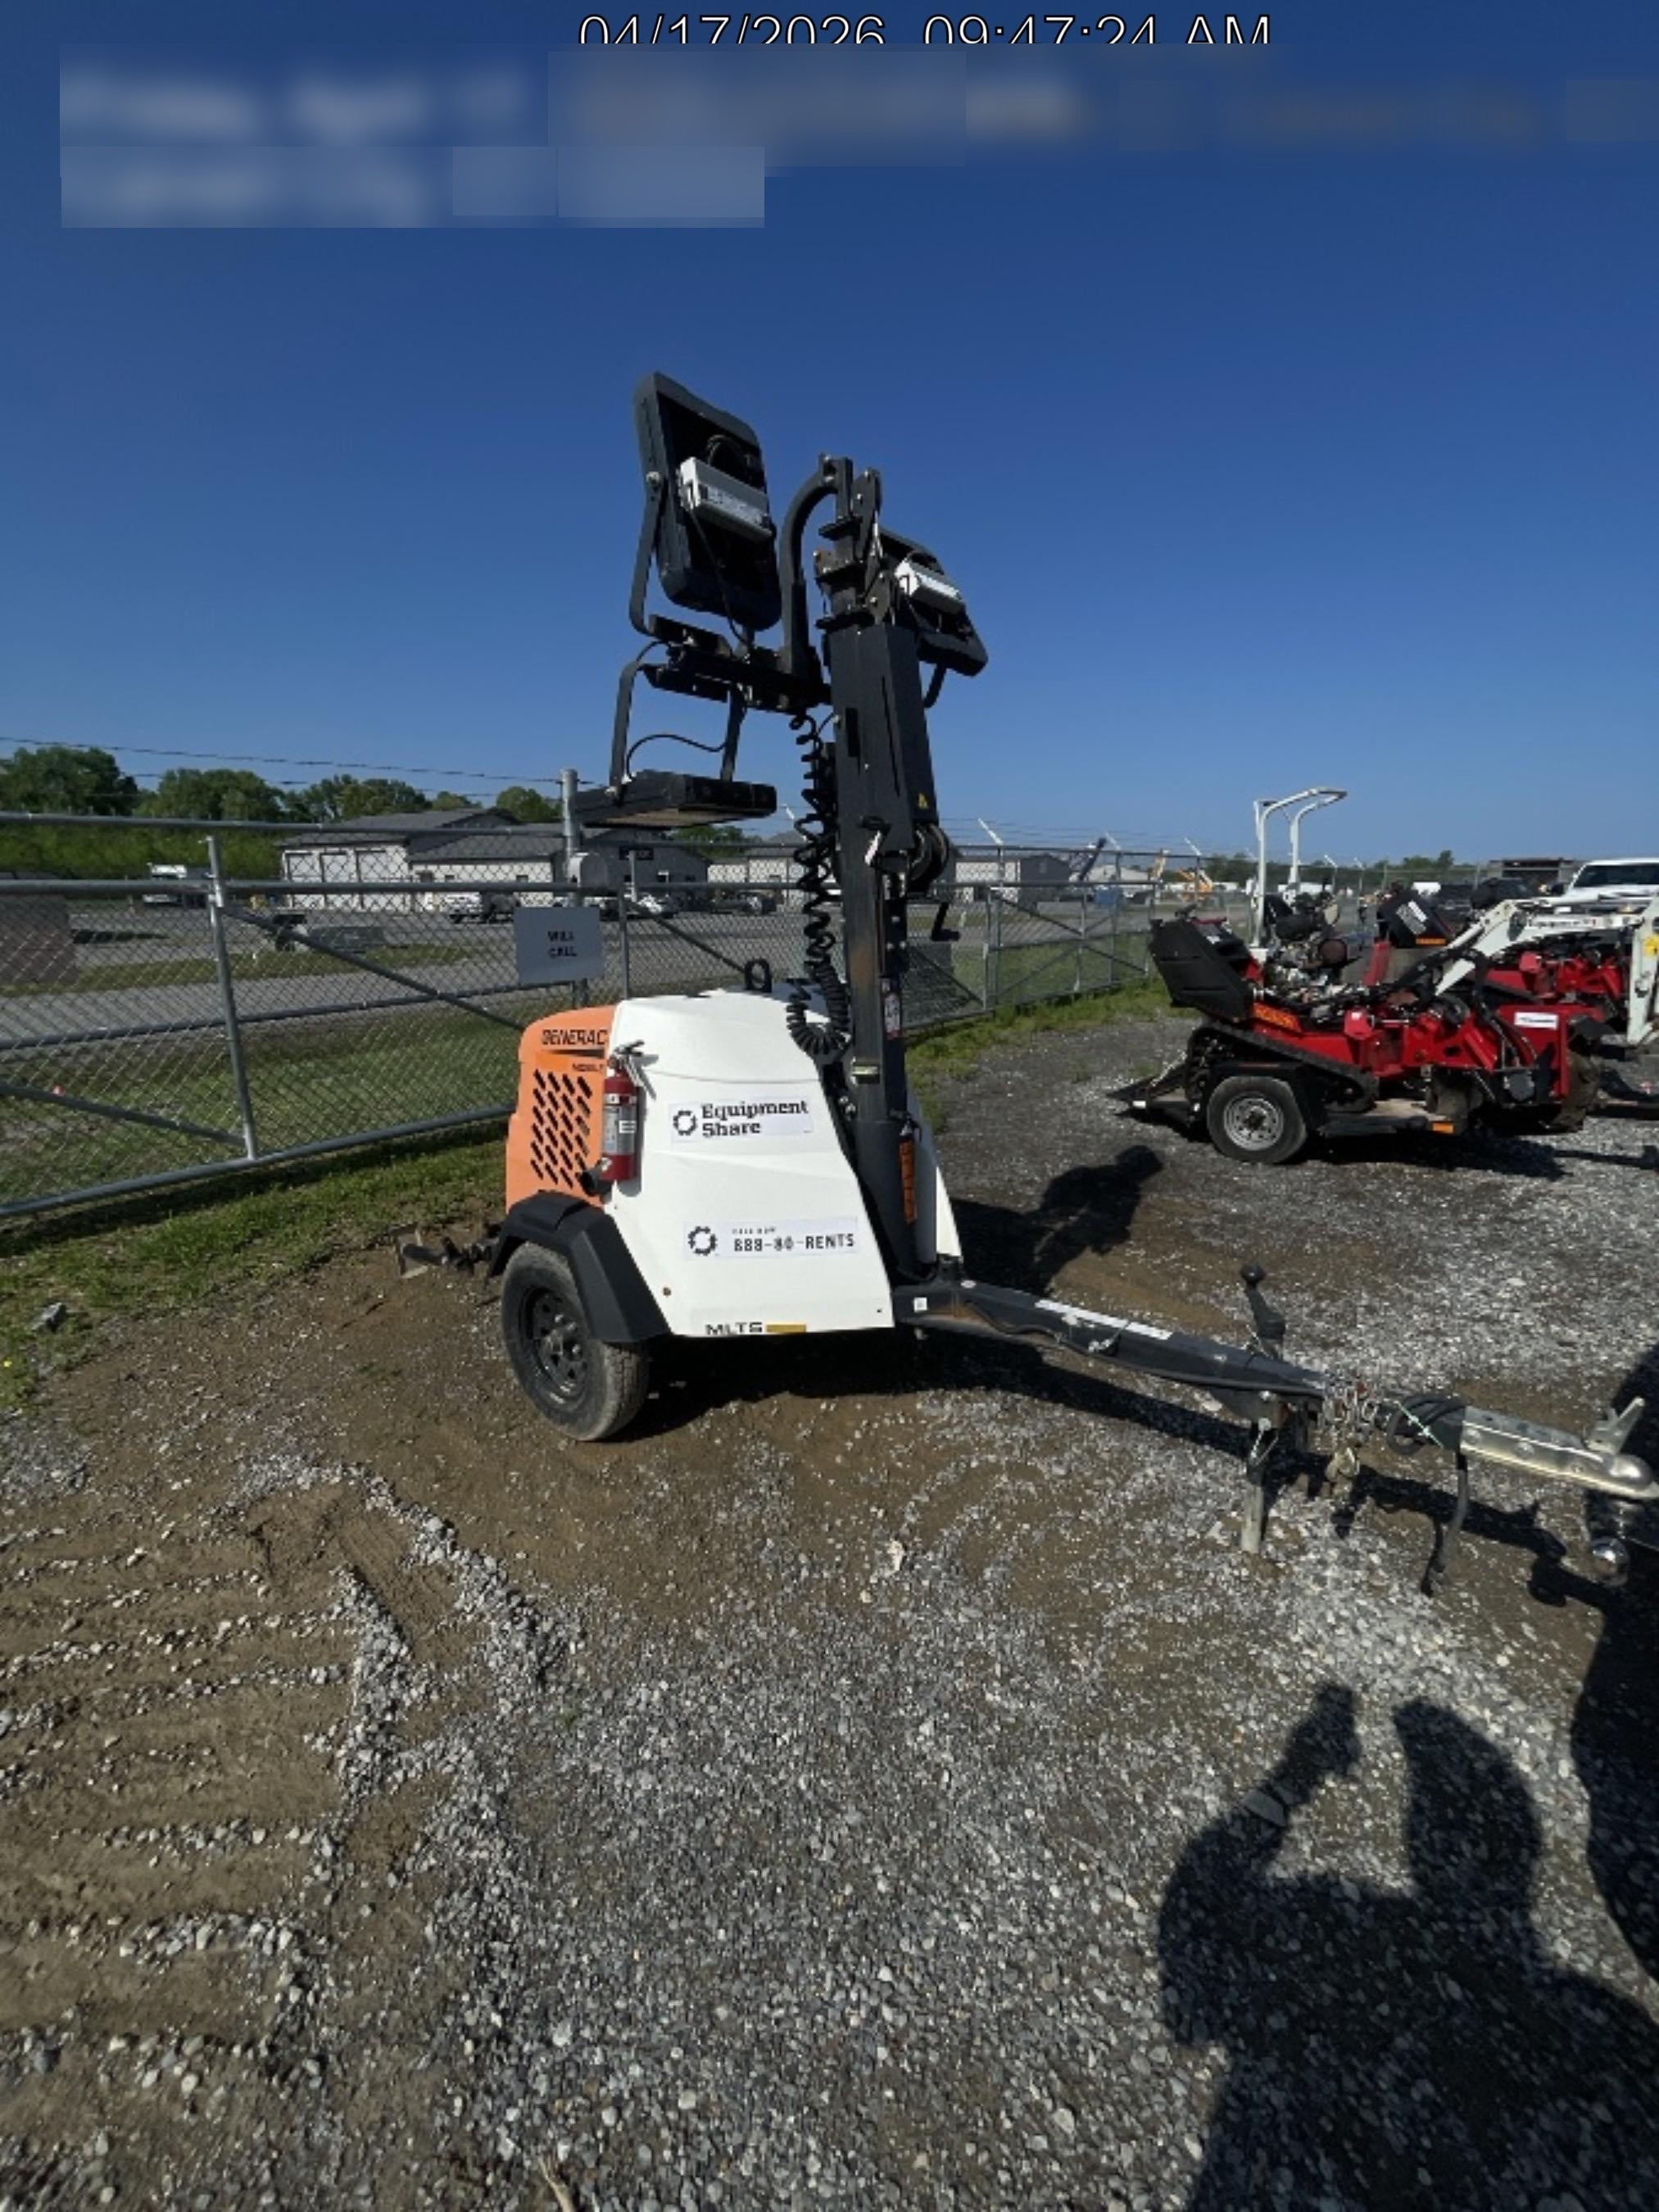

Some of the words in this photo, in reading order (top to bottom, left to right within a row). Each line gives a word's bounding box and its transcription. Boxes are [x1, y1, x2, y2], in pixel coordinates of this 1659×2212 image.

[542, 1028, 608, 1045] GENERAC
[701, 1100, 809, 1122] Equipment
[701, 1122, 761, 1139] Share
